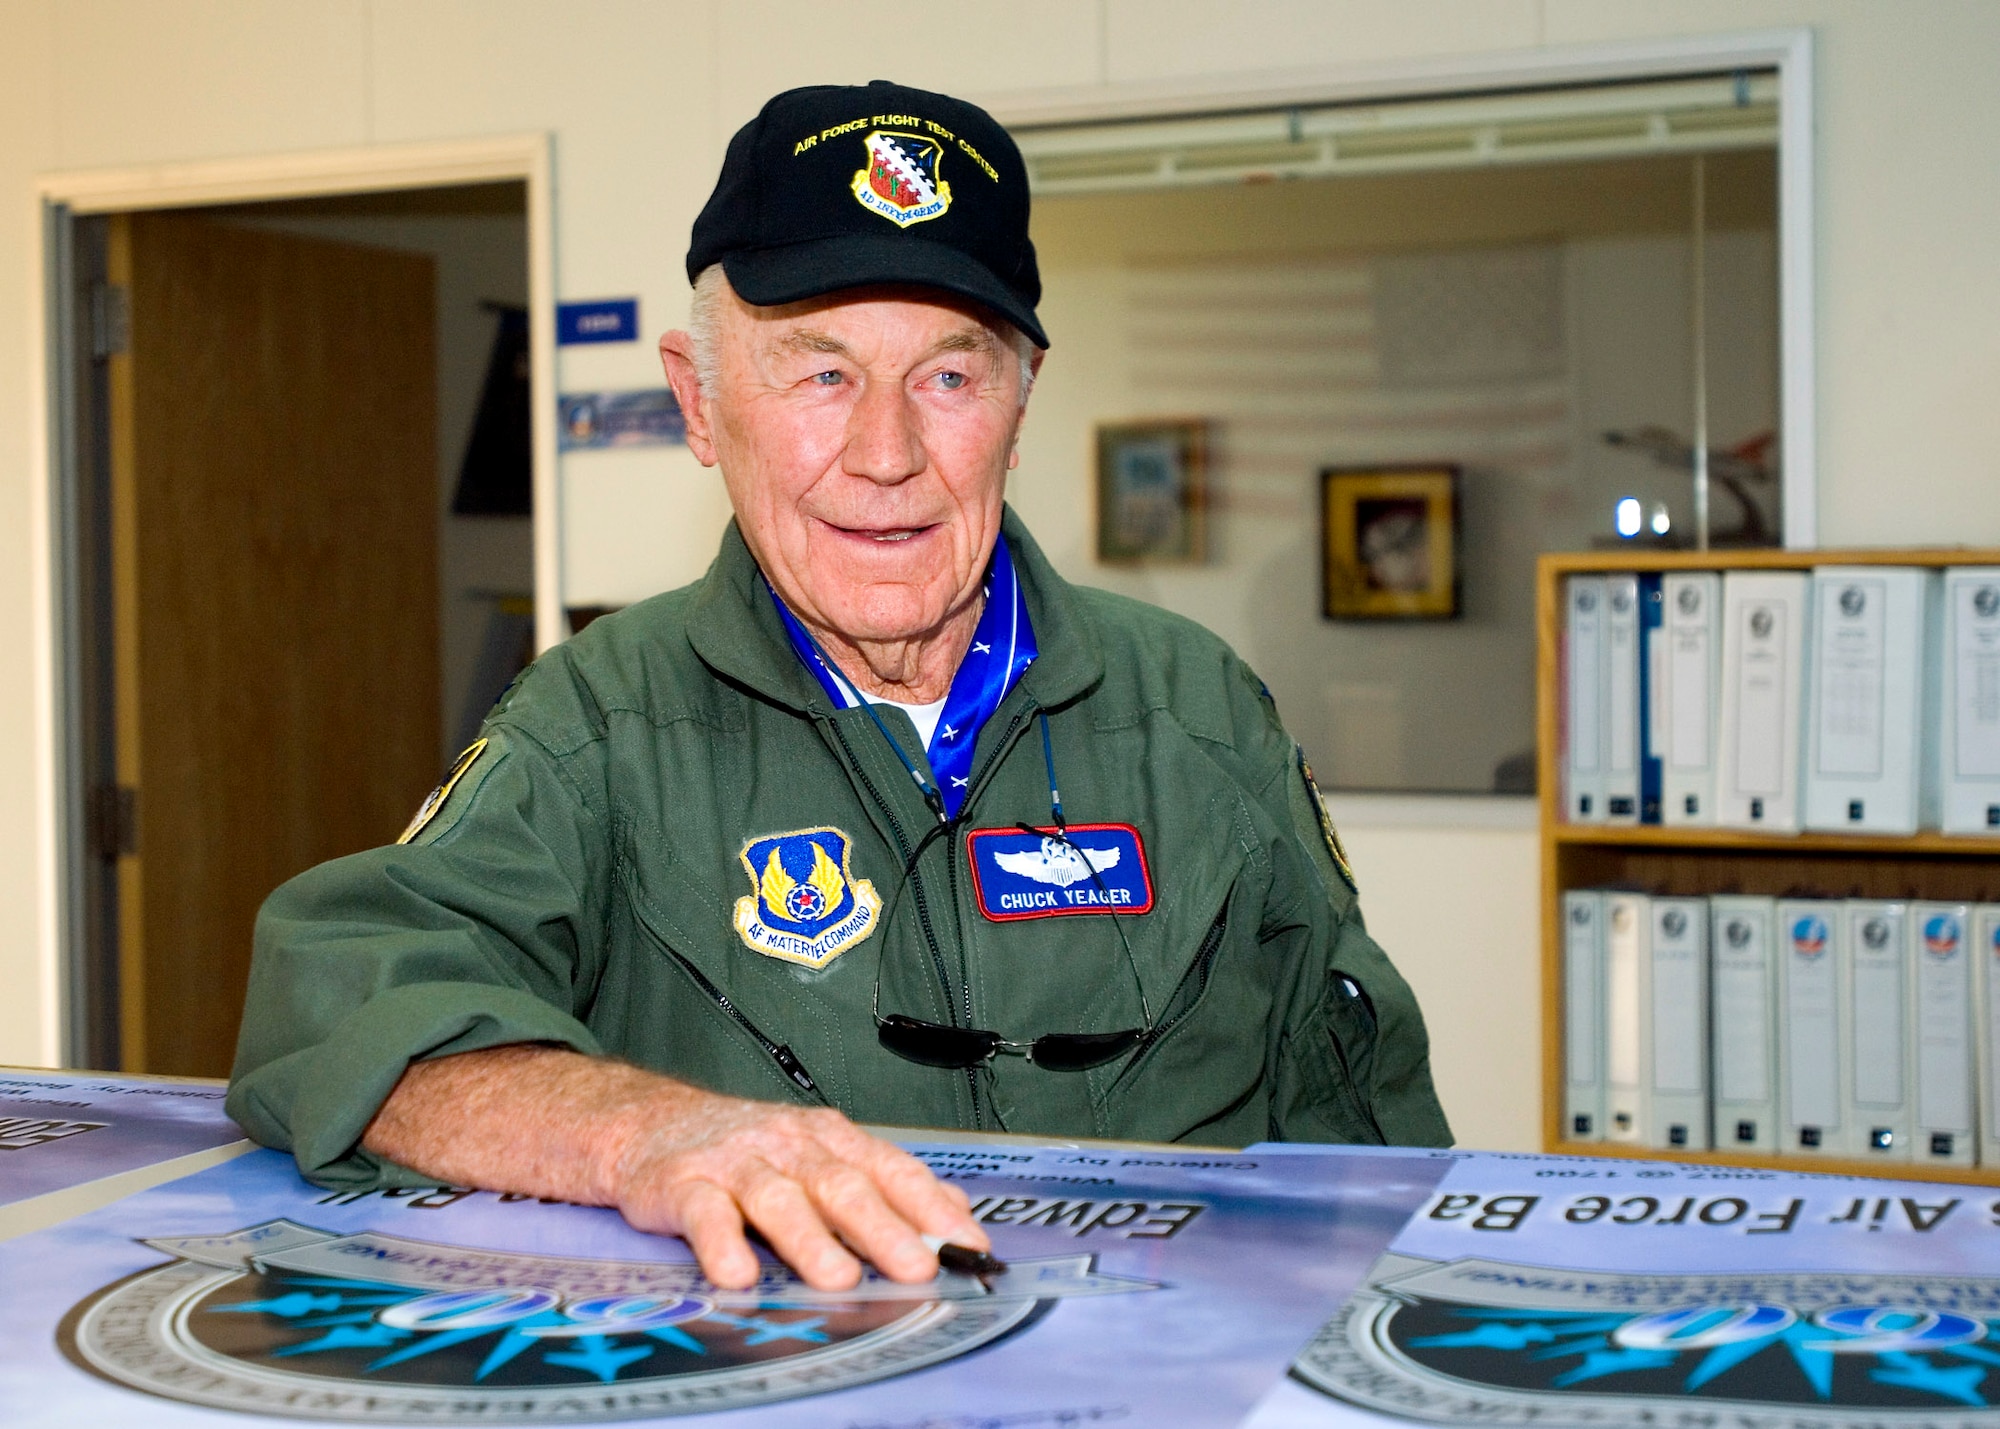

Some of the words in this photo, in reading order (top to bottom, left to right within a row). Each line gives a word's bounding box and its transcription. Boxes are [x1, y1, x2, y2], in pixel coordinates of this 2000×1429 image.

[793, 135, 818, 157] AIR
[821, 117, 868, 142] FORCE
[871, 113, 922, 128] FLIGHT
[925, 119, 956, 142] TEST
[956, 138, 1000, 183] CENTER
[860, 190, 875, 204] AD
[1000, 890, 1058, 910] CHUCK
[1064, 888, 1132, 905] YEAGER
[748, 922, 765, 940] AF
[766, 934, 826, 960] MATERIEL
[824, 905, 872, 949] COMMAND
[907, 1151, 1035, 1163] Bedazz
[1058, 1156, 1110, 1167] by:
[1120, 1159, 1259, 1170] Catered
[1005, 1174, 1116, 1186] When:
[1534, 1169, 1619, 1179] 1700
[1686, 1172, 1778, 1182] 2007
[970, 1197, 1207, 1240] Edwar
[1427, 1193, 1541, 1233] Ba
[1562, 1195, 1806, 1236] Force
[1828, 1196, 1961, 1233] Air
[378, 1287, 716, 1337] 60
[1611, 1304, 1990, 1354] 60
